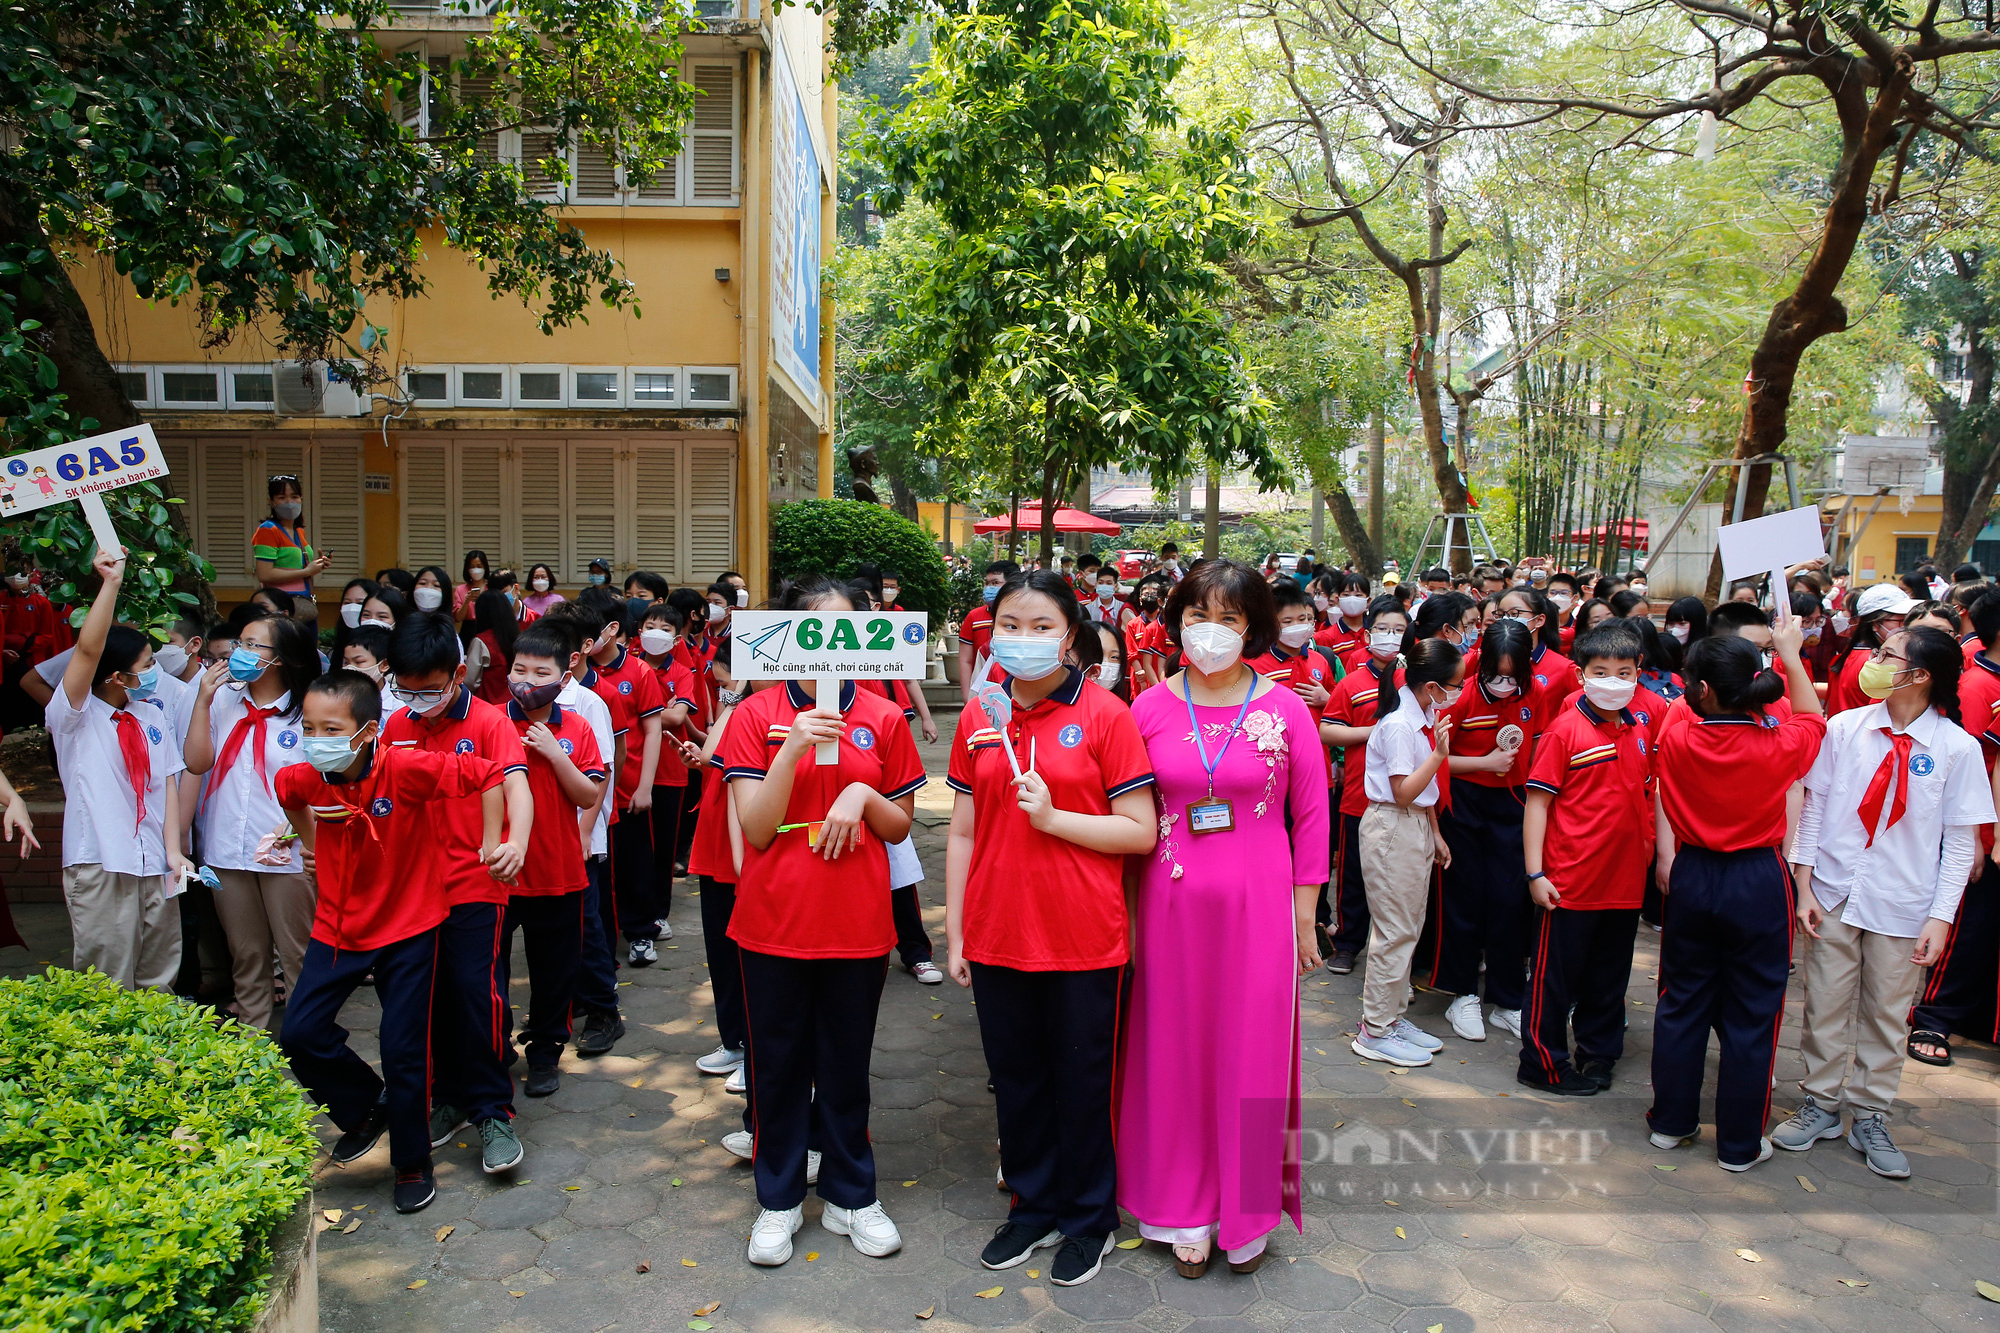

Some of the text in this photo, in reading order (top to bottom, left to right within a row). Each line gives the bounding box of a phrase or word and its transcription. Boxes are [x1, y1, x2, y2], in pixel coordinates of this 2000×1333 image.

[56, 436, 148, 482] 6A5
[64, 465, 161, 499] 5K không xa bạn bè
[796, 617, 896, 651] 6A2
[762, 660, 904, 674] Học cũng nhất, chơi cũng chất
